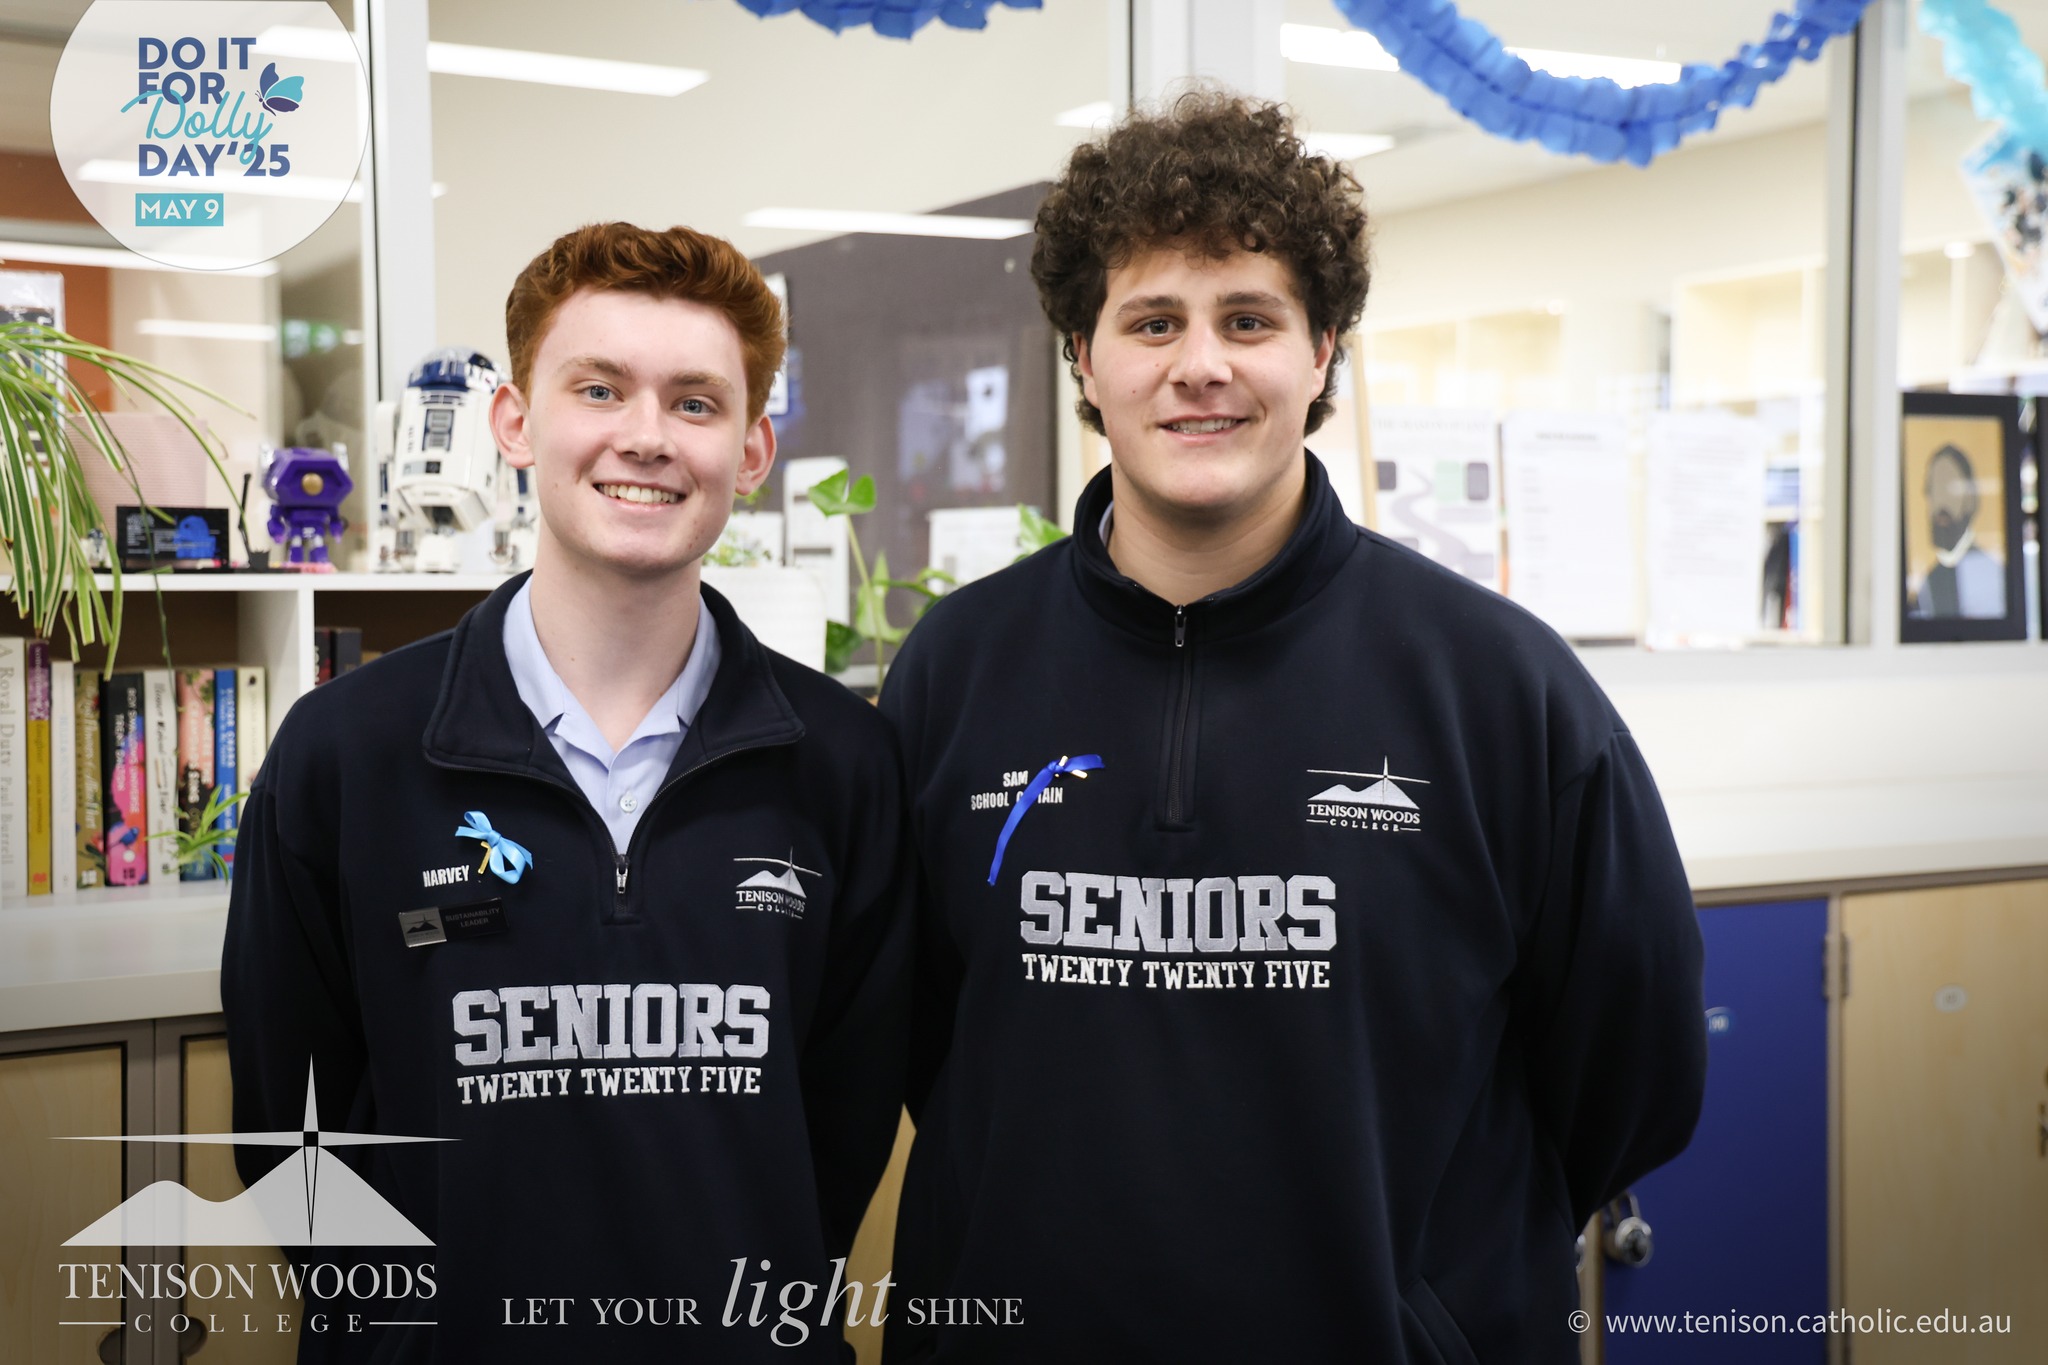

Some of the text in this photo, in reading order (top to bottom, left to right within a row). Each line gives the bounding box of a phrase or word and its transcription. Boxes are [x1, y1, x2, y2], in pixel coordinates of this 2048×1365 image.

[1003, 770, 1028, 787] SAM
[971, 791, 1009, 810] SCHOOL
[1307, 804, 1420, 824] TENISON WOODS
[1330, 819, 1399, 832] COLLEGE
[423, 865, 469, 887] HARVEY
[736, 890, 784, 904] TENISON
[445, 908, 500, 922] SUSTAINABILITY
[1020, 870, 1336, 953] SENIORS
[460, 917, 489, 928] LEADER
[1022, 953, 1330, 990] TWENTY TWENTY FIVE
[452, 983, 771, 1066] SENIORS
[457, 1066, 761, 1104] TWENTY TWENTY FIVE
